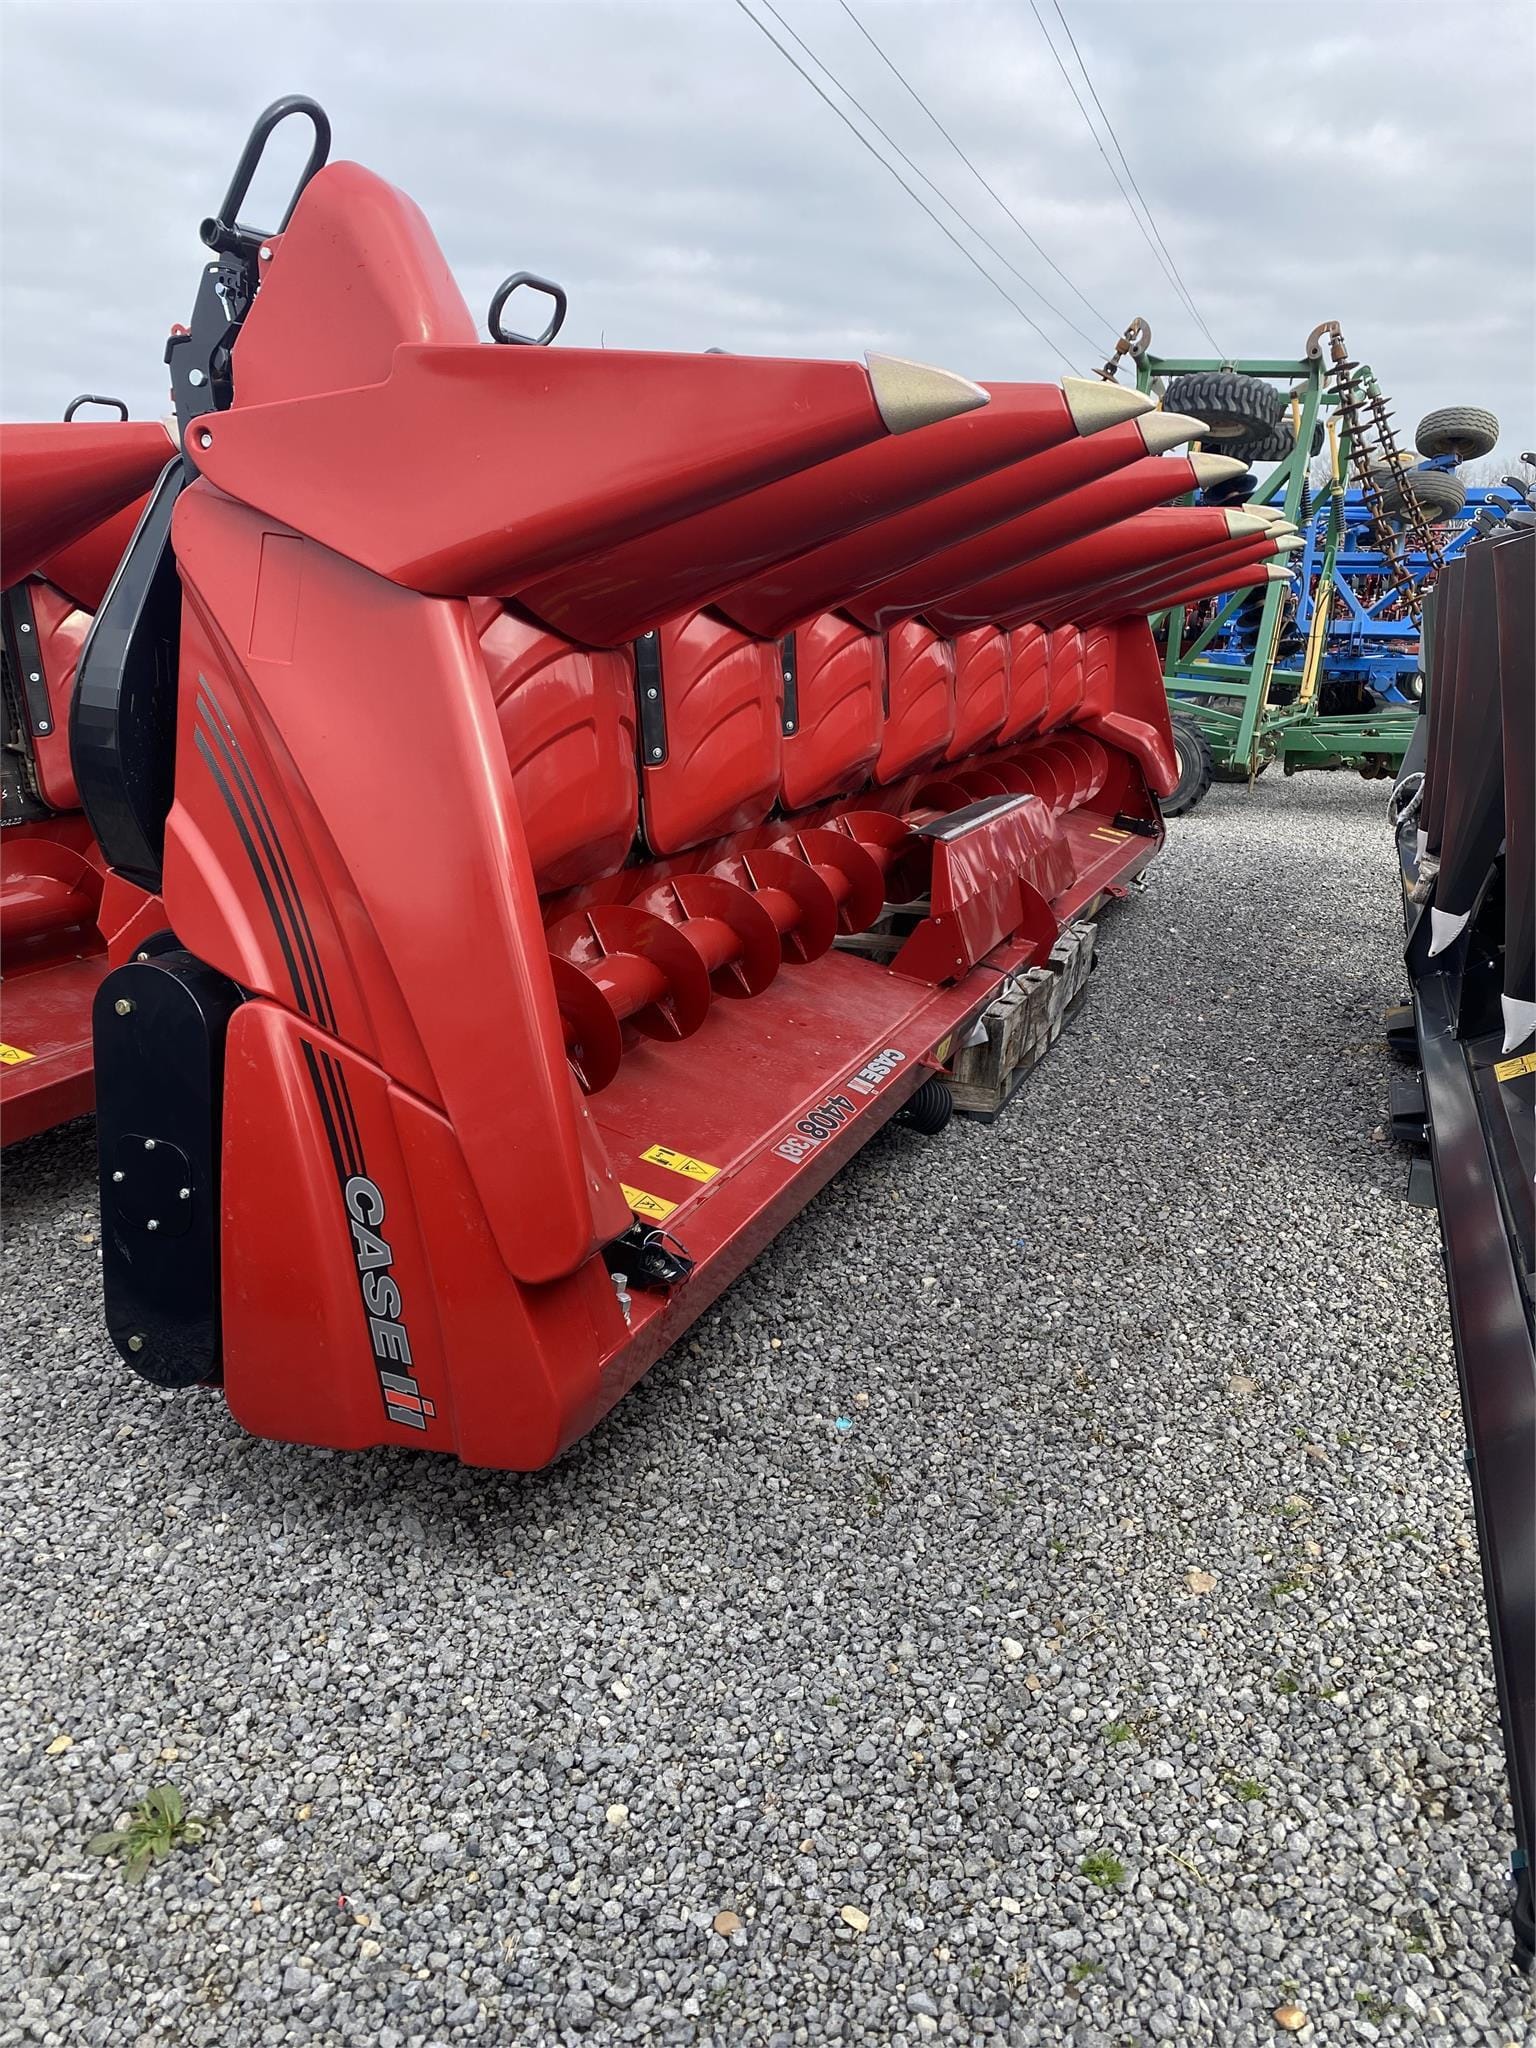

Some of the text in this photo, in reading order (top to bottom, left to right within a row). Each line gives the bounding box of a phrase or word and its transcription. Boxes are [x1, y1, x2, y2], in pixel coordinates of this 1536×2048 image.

[857, 1048, 906, 1084] CASE
[778, 1094, 857, 1157] 4408 38
[345, 1176, 413, 1365] CASE
